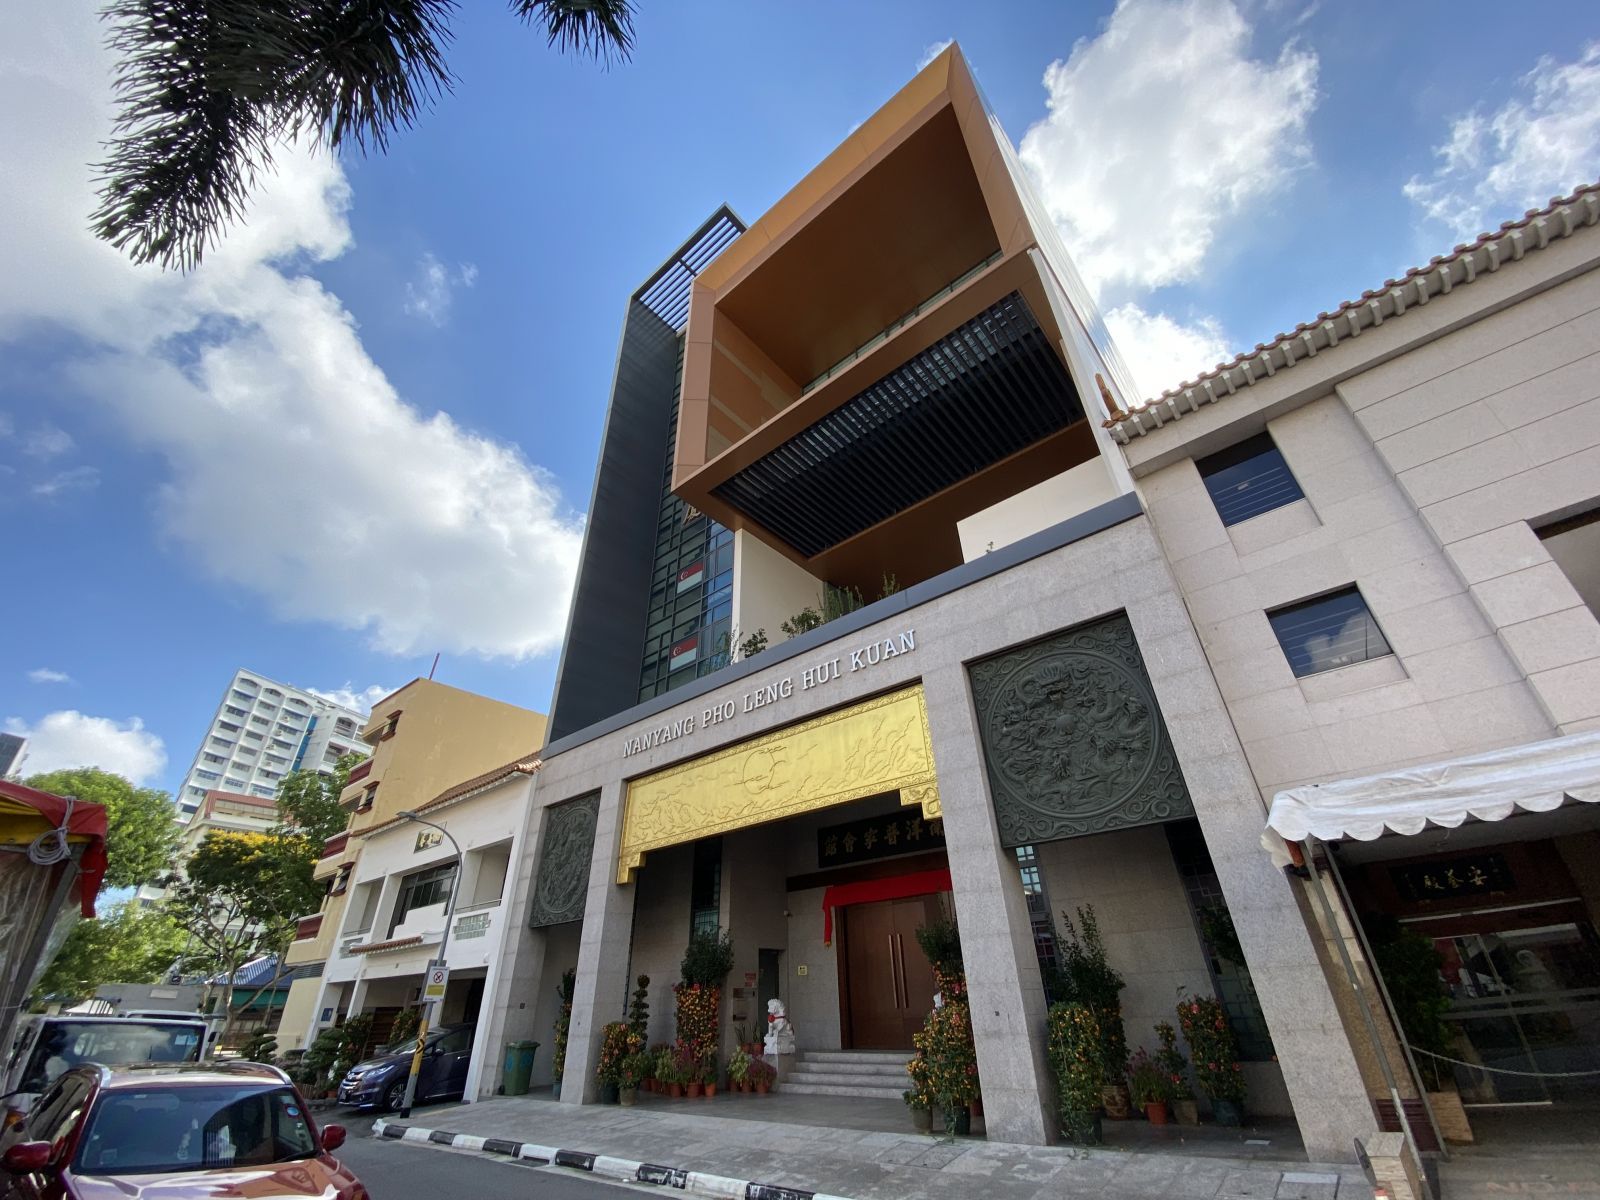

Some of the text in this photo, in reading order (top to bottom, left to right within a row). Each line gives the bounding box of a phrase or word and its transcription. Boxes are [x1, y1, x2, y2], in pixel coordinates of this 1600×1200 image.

[622, 629, 917, 758] NANYANG PHO LENG HUI KUAN
